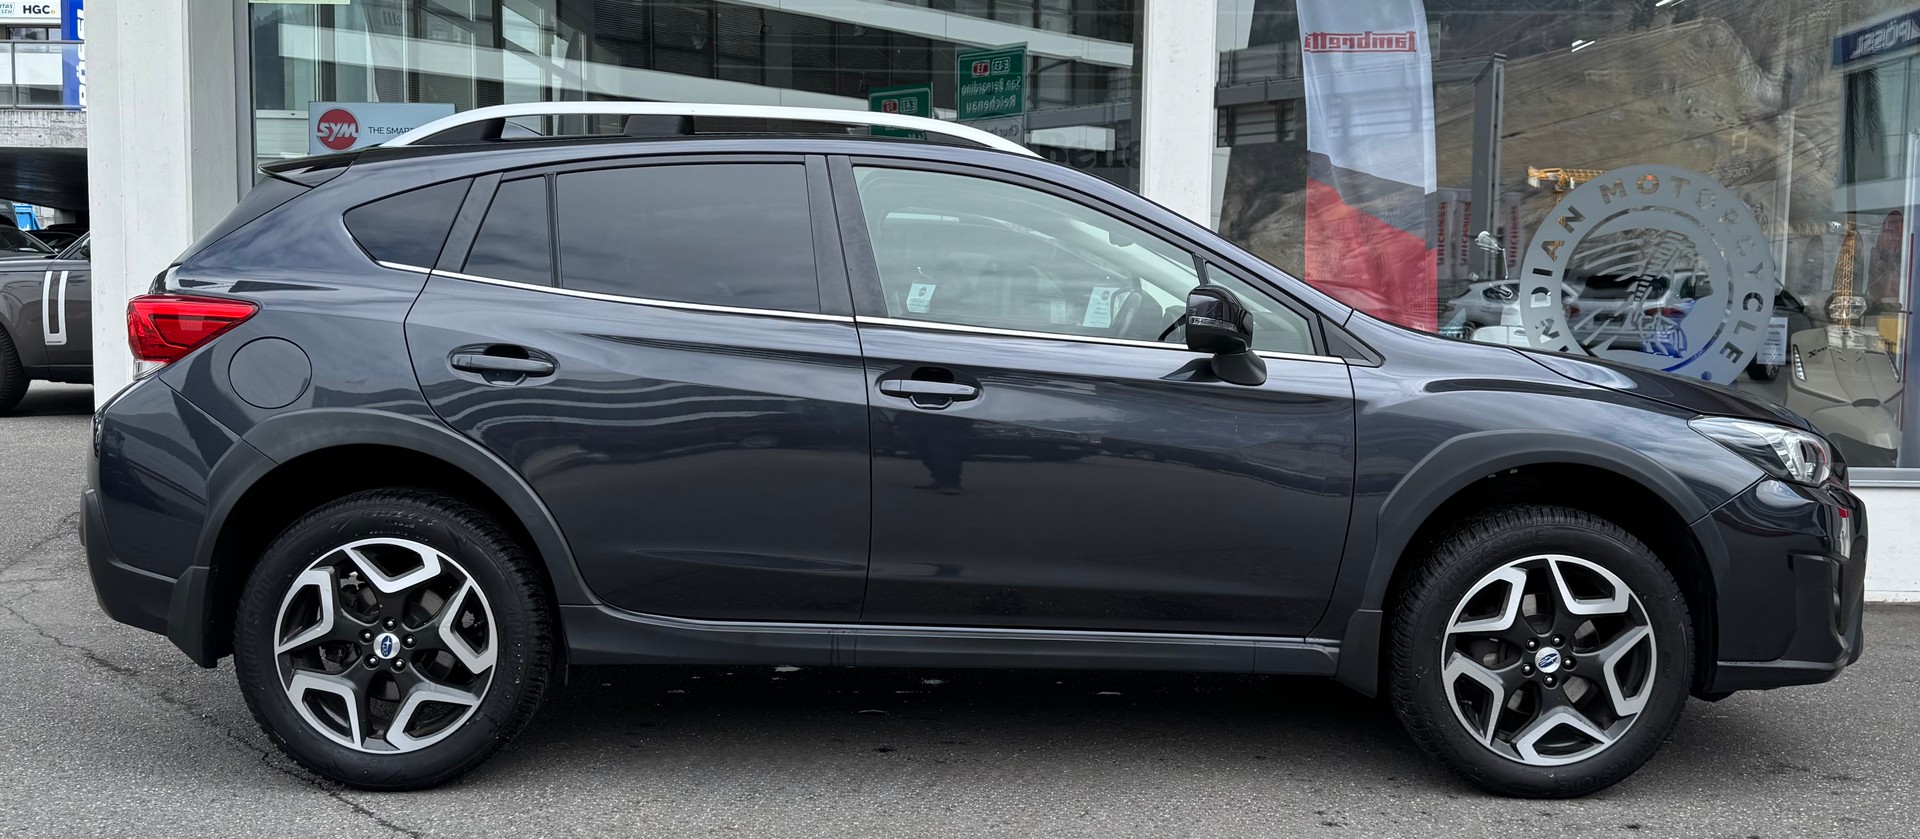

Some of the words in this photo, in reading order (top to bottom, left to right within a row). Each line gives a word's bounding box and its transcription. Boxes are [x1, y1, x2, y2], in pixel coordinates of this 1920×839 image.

[23, 5, 50, 14] HGC
[316, 122, 360, 142] SYM
[368, 126, 384, 134] THE
[1530, 205, 1586, 352] NDIAN
[1598, 174, 1764, 365] MOTORCYCLE
